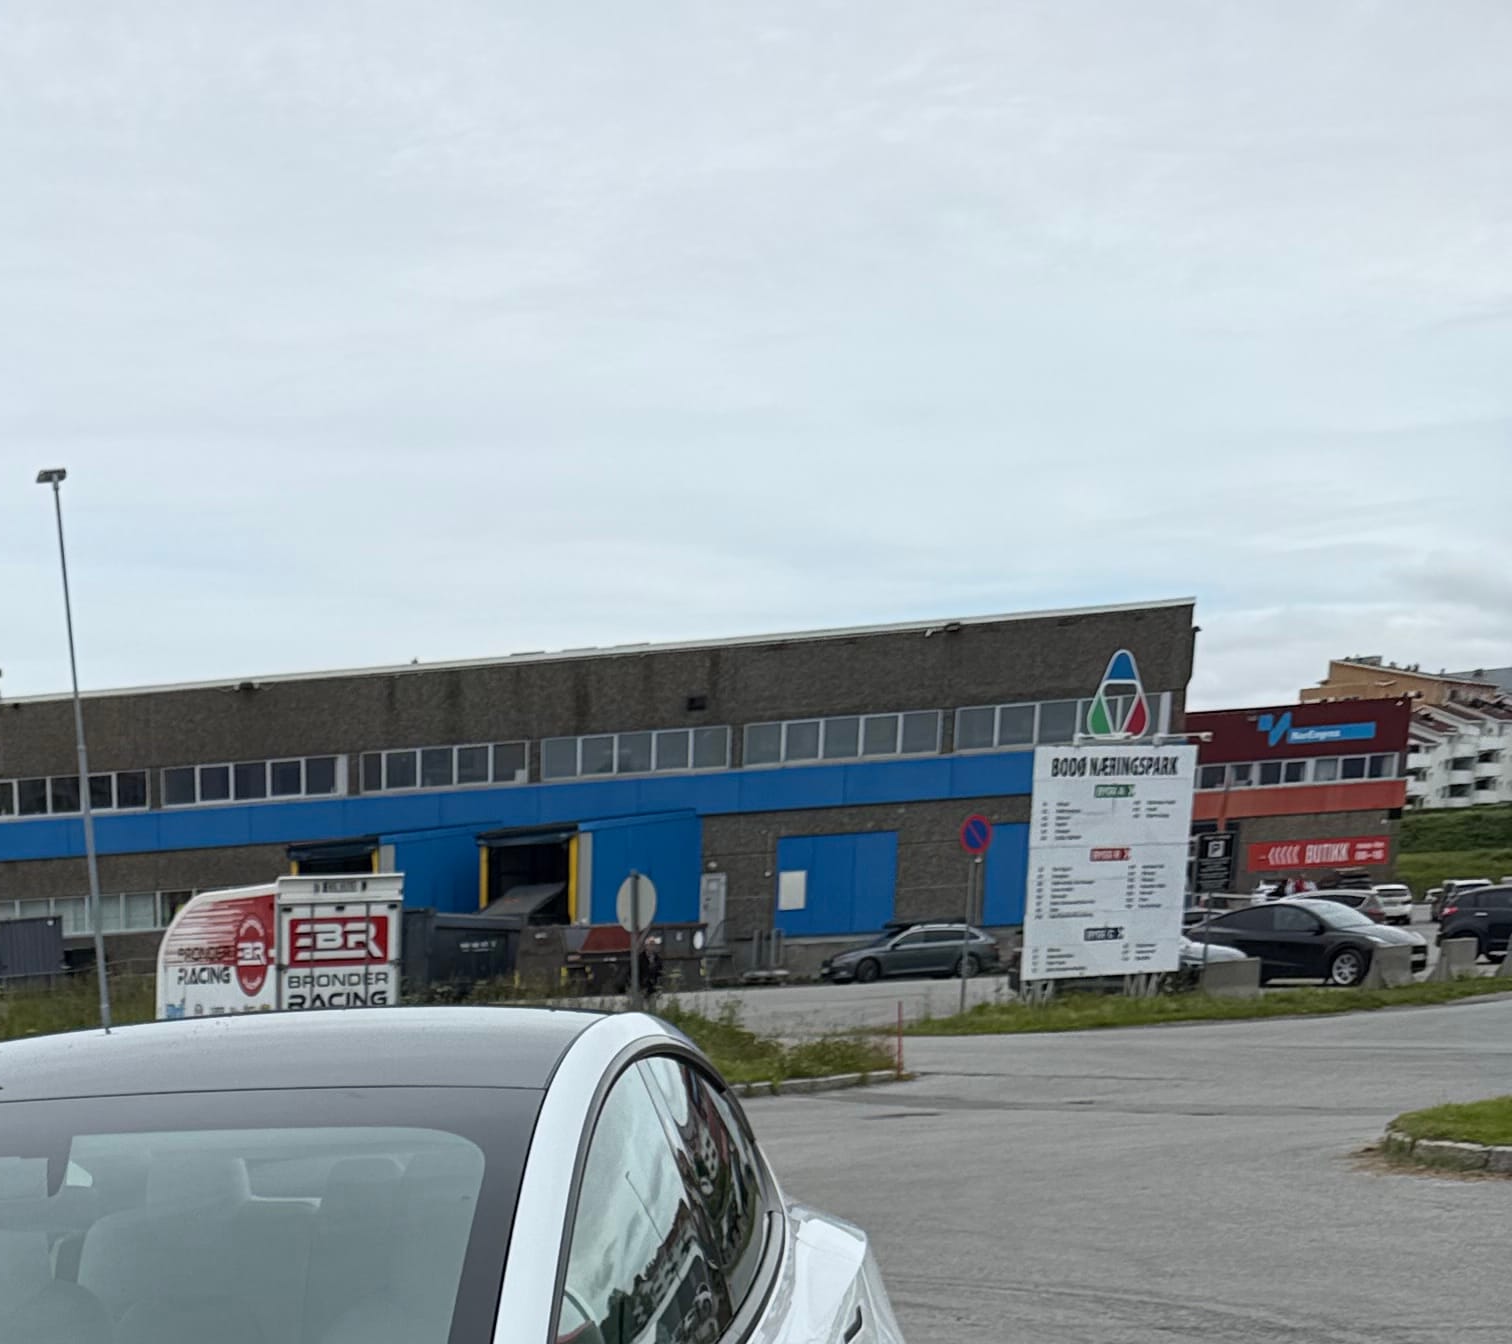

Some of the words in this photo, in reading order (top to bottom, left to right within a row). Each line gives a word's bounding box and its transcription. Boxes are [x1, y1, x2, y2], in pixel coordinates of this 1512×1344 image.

[1051, 756, 1087, 777] BODØ
[1089, 756, 1179, 777] NÆRINGSPARK
[1304, 842, 1351, 865] BUTIKK
[177, 966, 231, 985] RACING
[287, 971, 389, 989] BRONDER
[287, 990, 388, 1010] RACING
